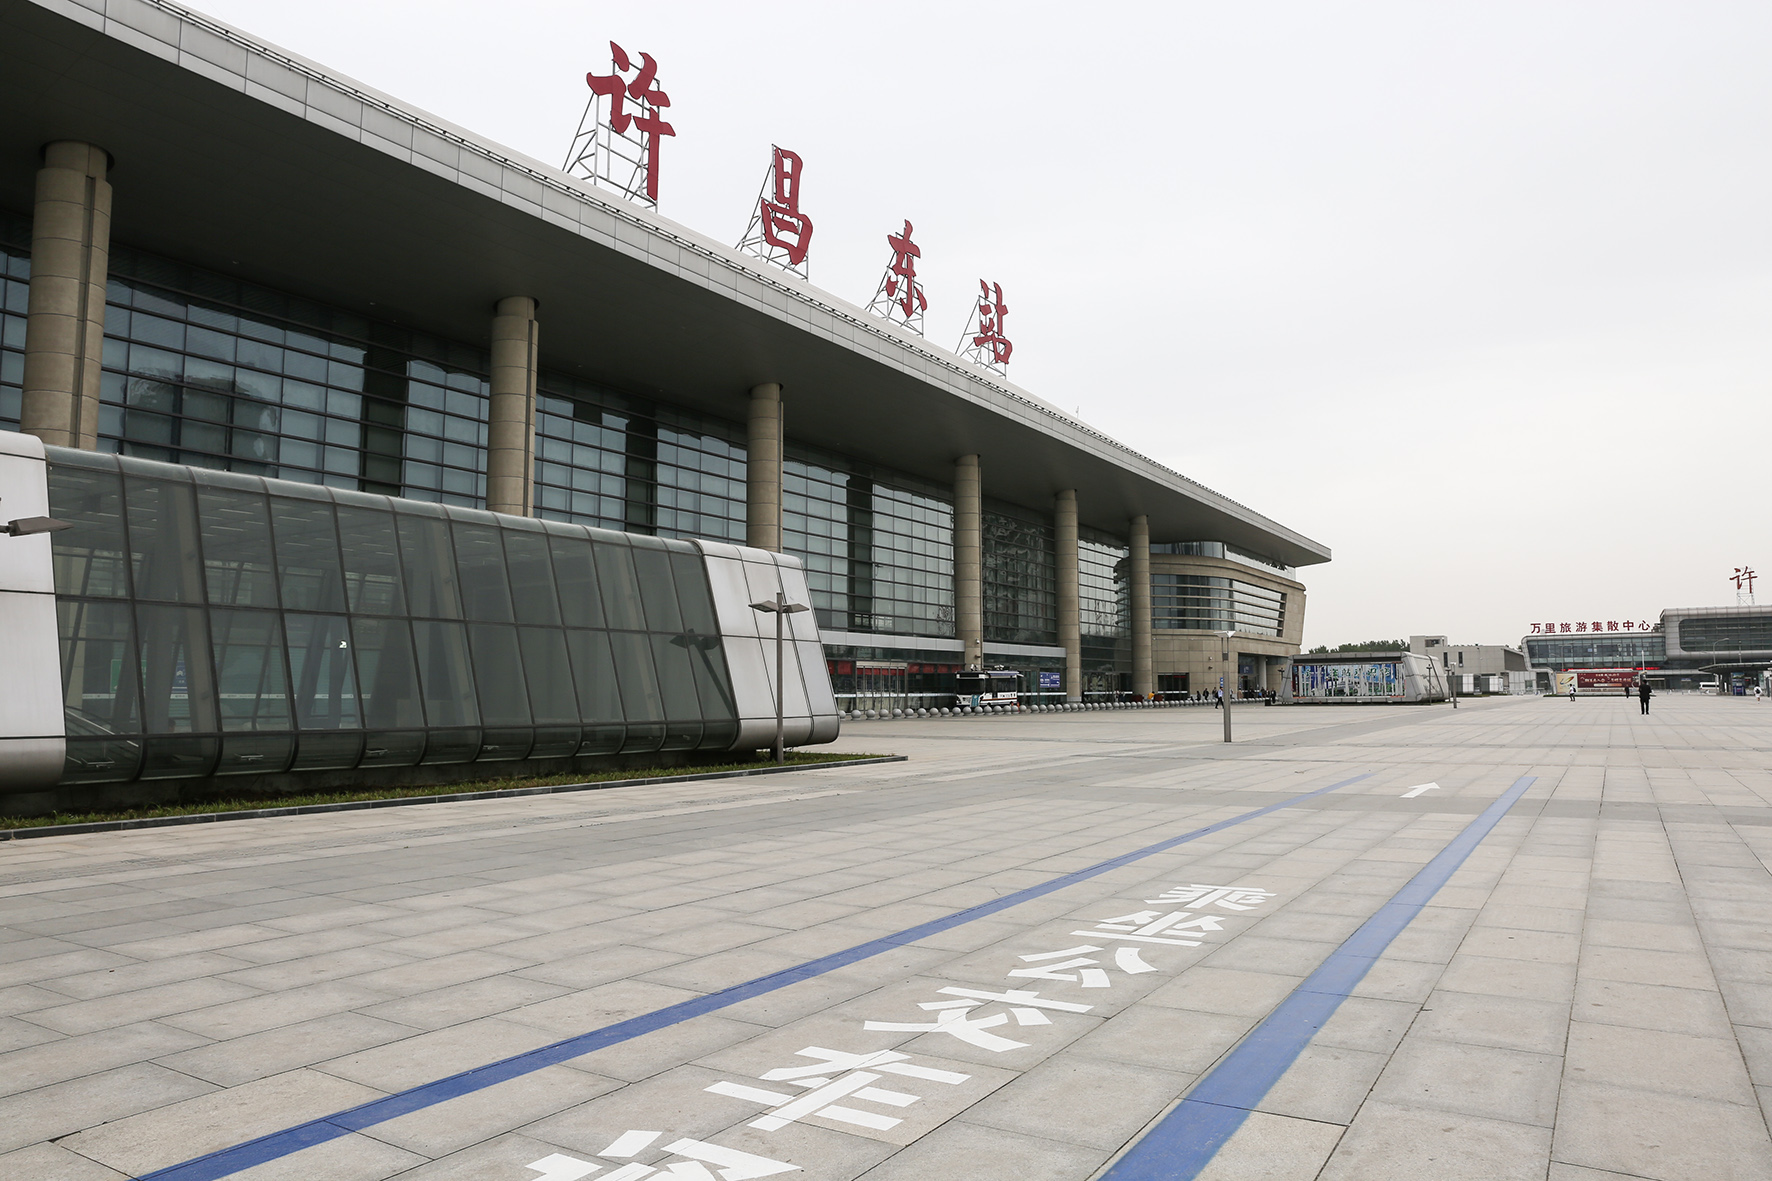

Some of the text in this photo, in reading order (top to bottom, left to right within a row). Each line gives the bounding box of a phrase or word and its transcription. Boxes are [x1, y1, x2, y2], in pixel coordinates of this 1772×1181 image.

[586, 41, 1013, 364] 许昌东站
[1729, 566, 1758, 593] 许
[1530, 620, 1651, 634] 万里旅游集散中心
